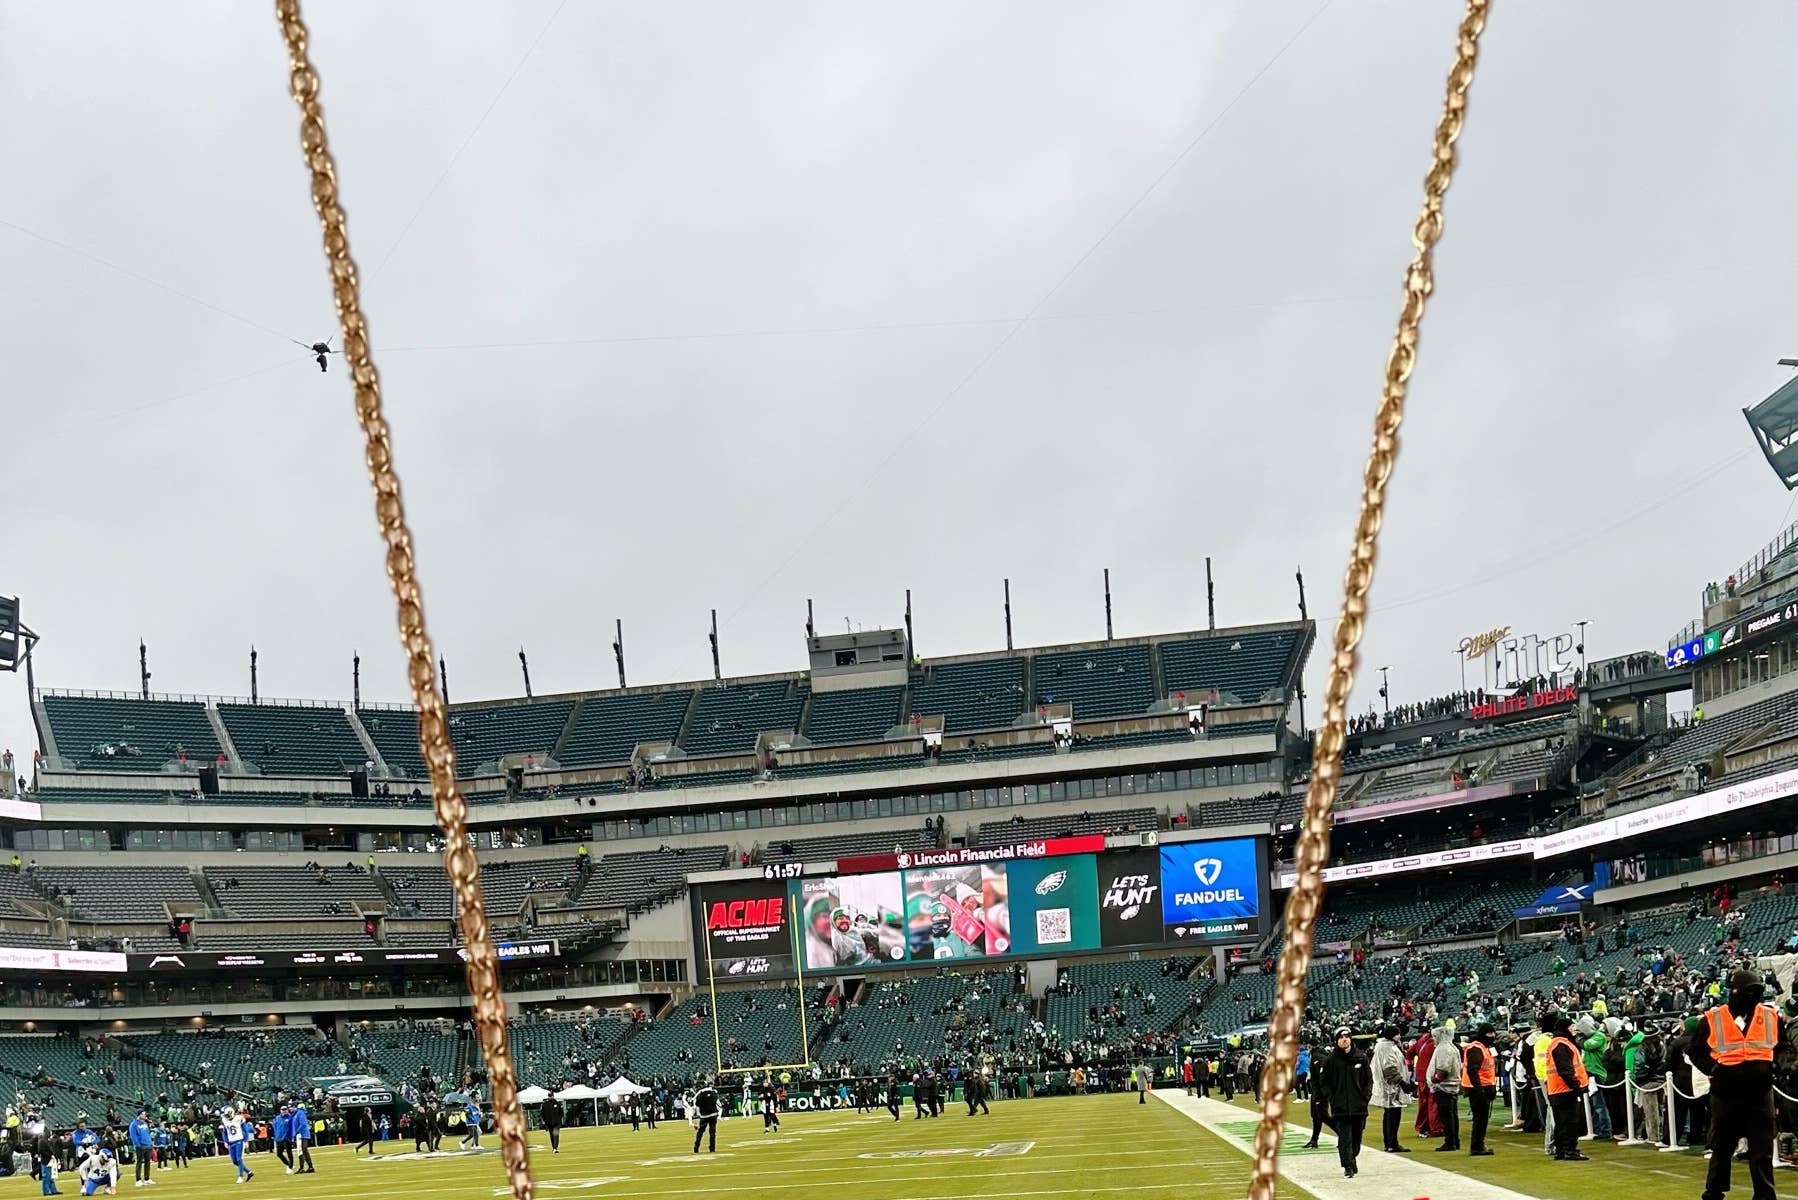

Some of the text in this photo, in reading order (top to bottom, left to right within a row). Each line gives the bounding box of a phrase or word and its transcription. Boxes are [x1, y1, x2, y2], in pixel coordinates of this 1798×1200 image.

[1747, 612, 1781, 634] PREGAME
[1459, 625, 1511, 661] Miller
[1484, 632, 1573, 697] Lite
[1471, 684, 1578, 719] PHLITE DECK
[914, 842, 1046, 865] Lincoln Financial Field
[765, 863, 803, 879] 61:57
[1112, 874, 1149, 889] LET'S
[1103, 885, 1158, 908] HUNT
[1175, 888, 1245, 906] FANDUEL
[1536, 906, 1559, 914] xfinity
[1190, 922, 1248, 935] FREE EAGLES WIFI
[498, 946, 530, 957] EAGLES
[746, 963, 771, 973] HUNT
